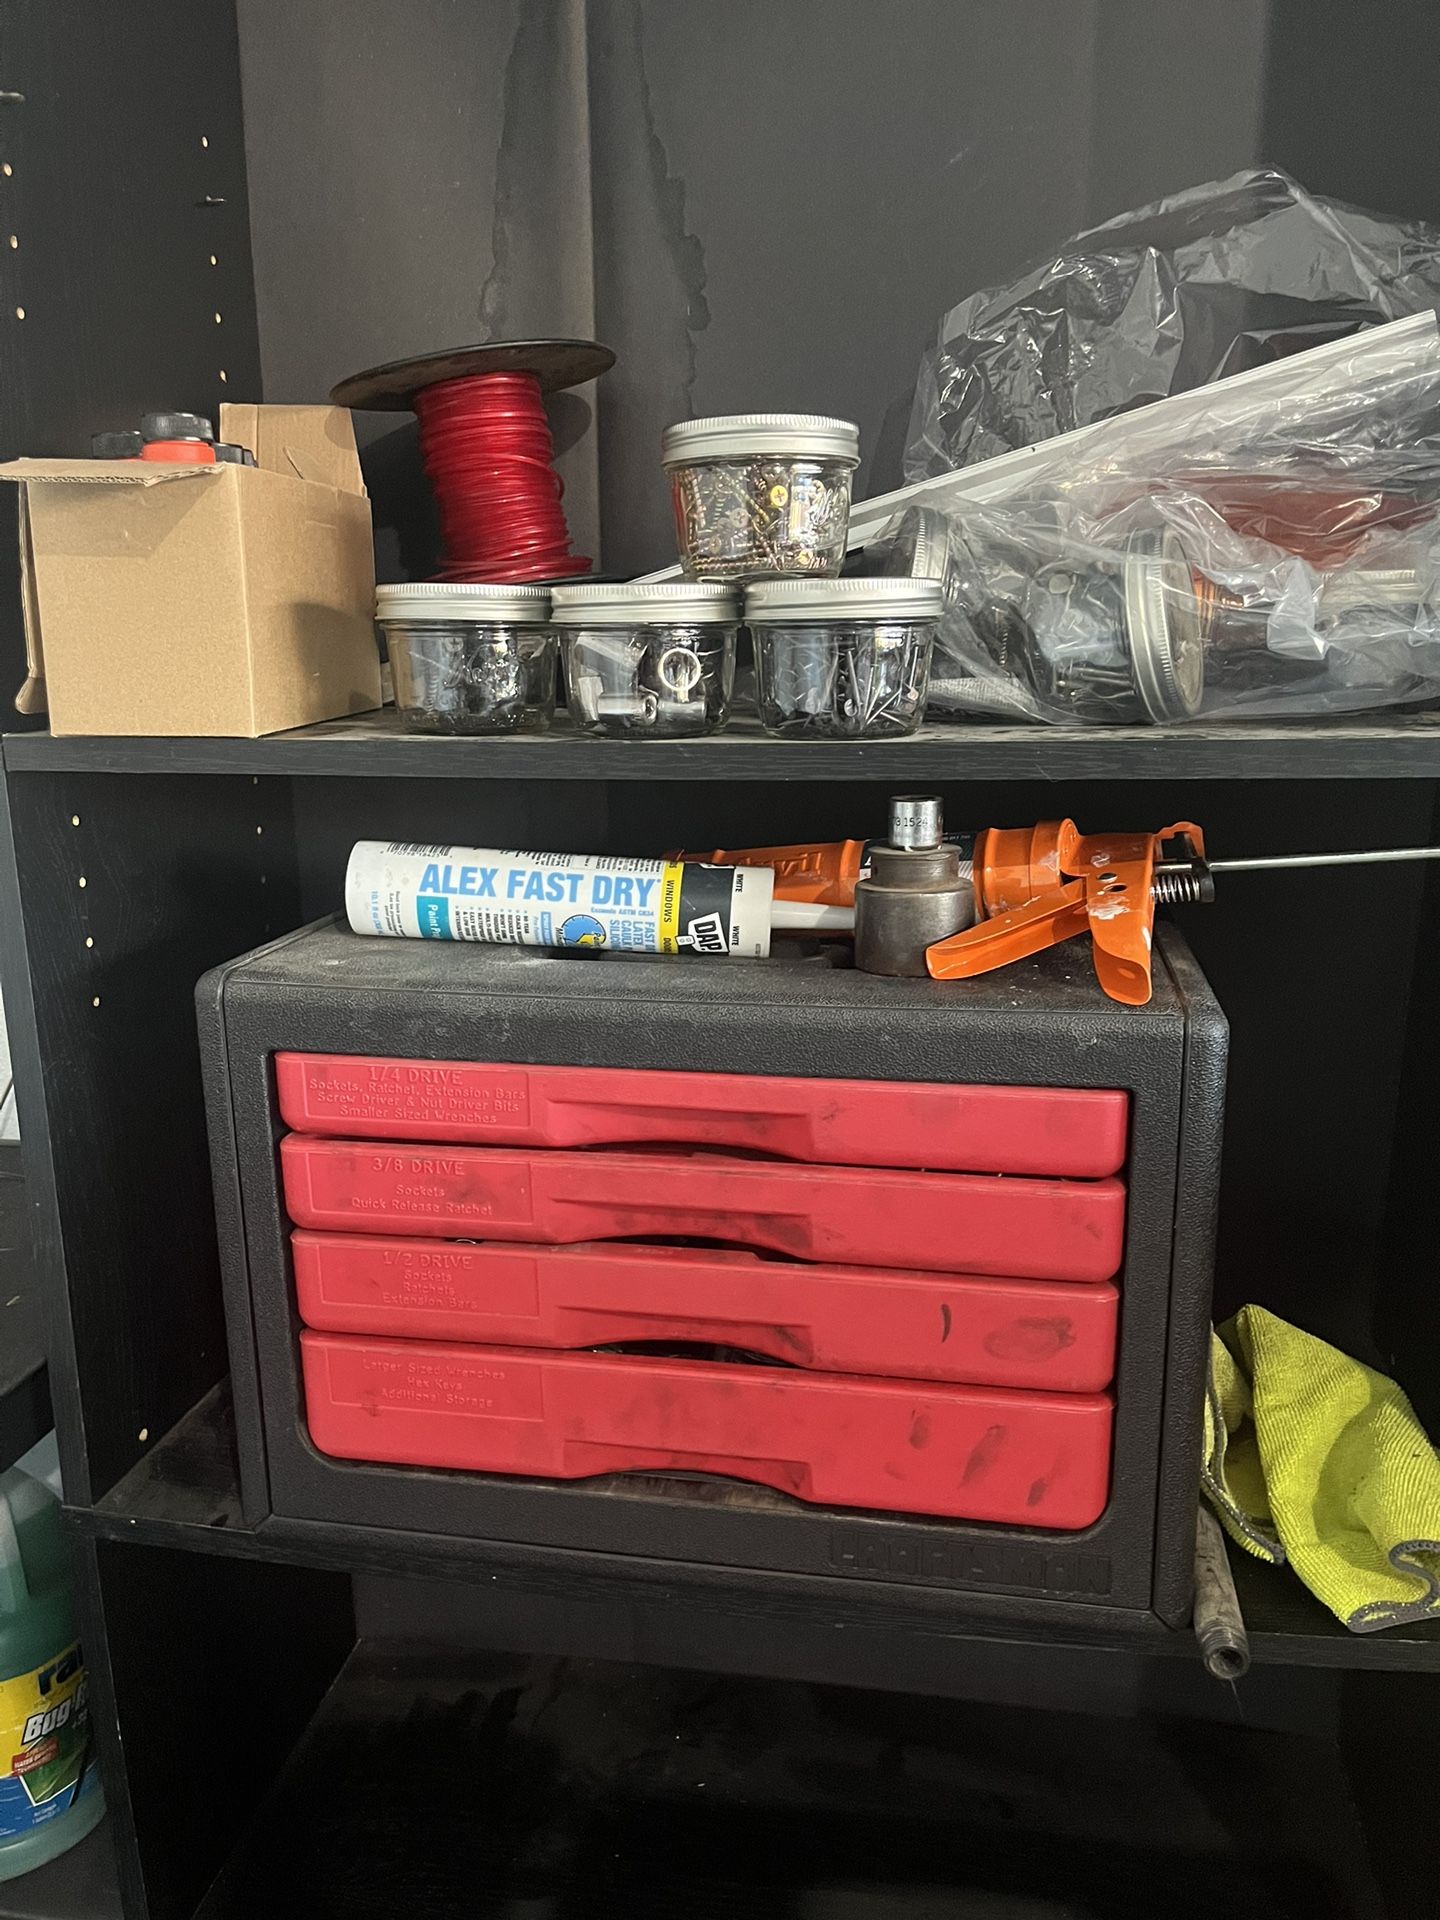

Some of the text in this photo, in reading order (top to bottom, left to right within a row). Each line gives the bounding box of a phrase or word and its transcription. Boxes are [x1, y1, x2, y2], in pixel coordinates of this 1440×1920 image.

[418, 864, 656, 908] ALEX FAST DRY
[735, 873, 744, 893] WHITE
[663, 879, 675, 923] WINDOWS
[427, 904, 439, 927] Paint
[621, 920, 633, 947] CAULK
[633, 921, 644, 946] LATEX
[644, 921, 656, 943] FAST
[731, 926, 740, 946] WHITE
[369, 1065, 464, 1086] 1/4 DRIVE
[426, 1084, 489, 1099] Extension
[494, 1088, 527, 1100] Bars
[361, 1094, 400, 1107] Driver
[420, 1097, 444, 1109] Nut
[449, 1098, 490, 1112] Driver
[494, 1099, 521, 1113] Bits
[339, 1104, 498, 1124] Smaller Sized Wrenches
[372, 1157, 466, 1176] 3/8 DRIVE
[395, 1184, 446, 1198] Sockets
[351, 1196, 494, 1216] Quick Release Ratchet
[383, 1251, 474, 1270] 1/2 DRIVE
[404, 1270, 453, 1283] Sockets
[382, 1292, 445, 1306] Extension
[407, 1362, 441, 1375] Sized
[407, 1377, 463, 1392] Hex Keys
[446, 1393, 494, 1408] Storage
[22, 1696, 72, 1745] Bug
